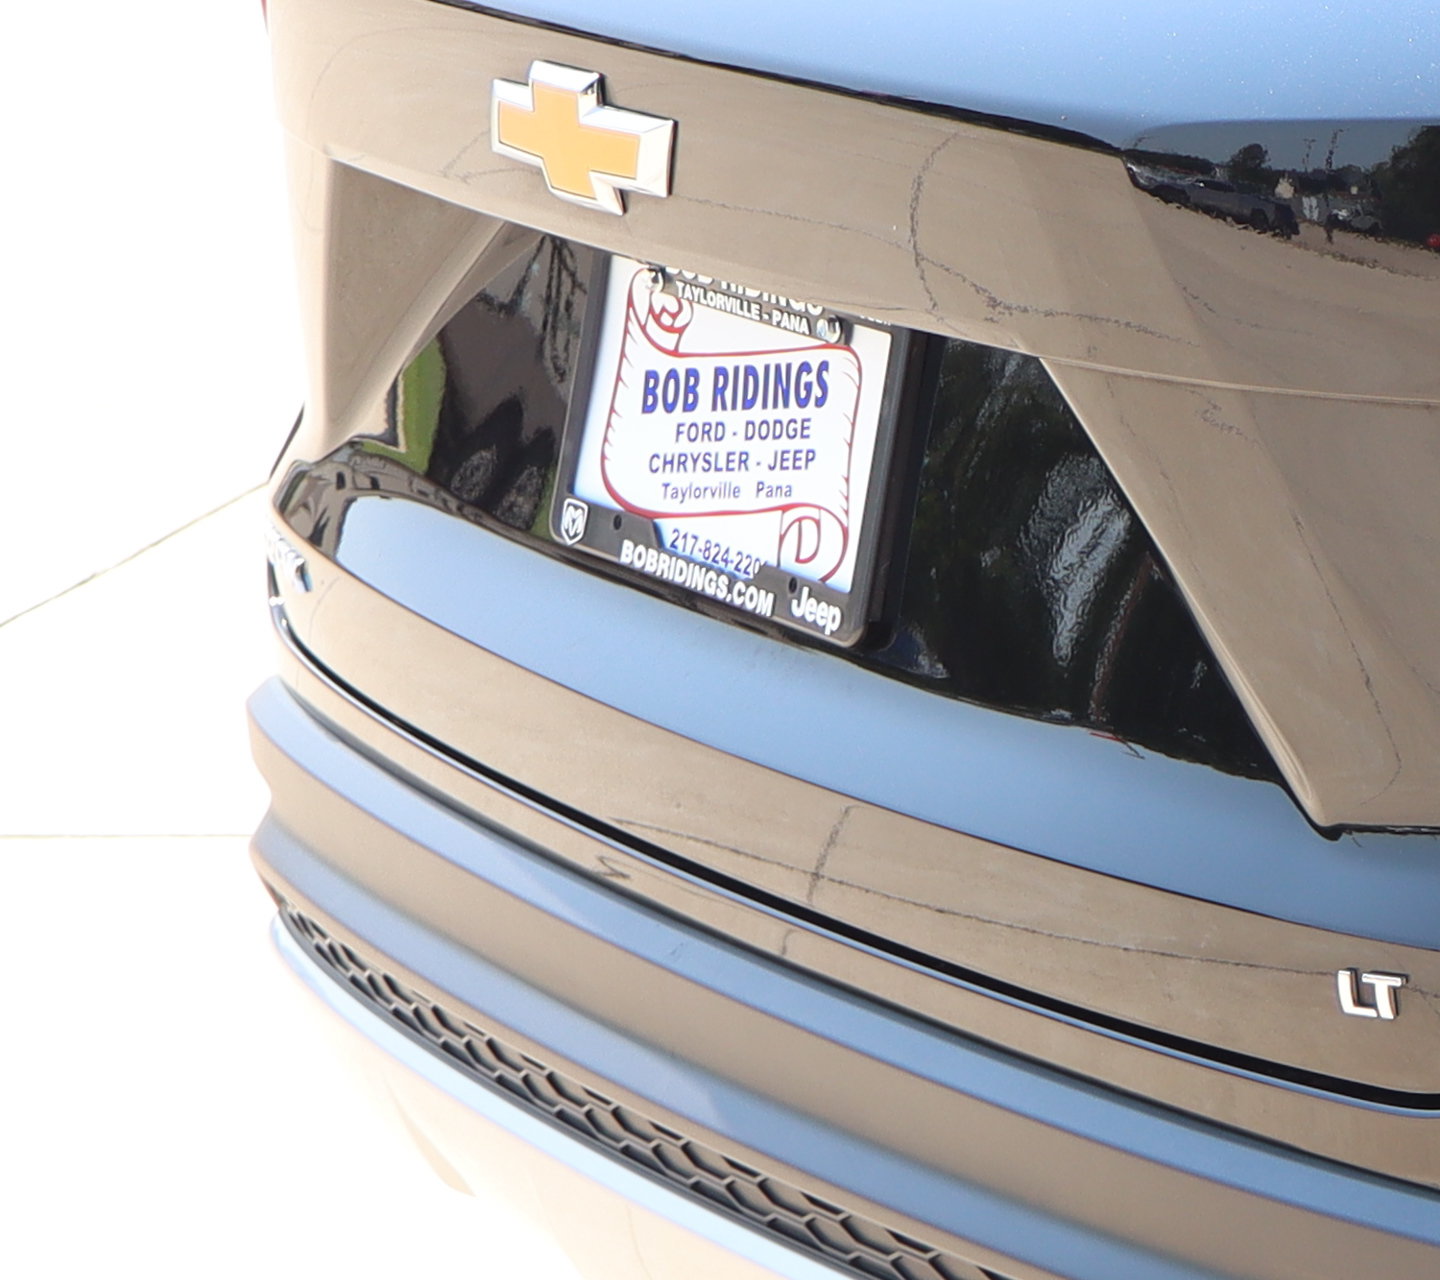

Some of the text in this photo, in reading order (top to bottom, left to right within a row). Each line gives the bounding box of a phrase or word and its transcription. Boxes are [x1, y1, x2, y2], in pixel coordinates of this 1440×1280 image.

[675, 280, 762, 321] TAYLORVILLE
[771, 309, 811, 335] PANA
[642, 360, 830, 414] BOB RIDINGS
[675, 422, 726, 443] FORD
[744, 418, 812, 442] DODGE
[649, 451, 750, 473] CHRYSLER
[767, 449, 816, 472] JEEP
[661, 481, 793, 504] Taylorville Pana
[669, 528, 768, 576] 217-824-220
[619, 540, 775, 617] BOBRIDINGS.COM
[791, 586, 842, 635] Jeep
[1338, 969, 1404, 1020] LT
